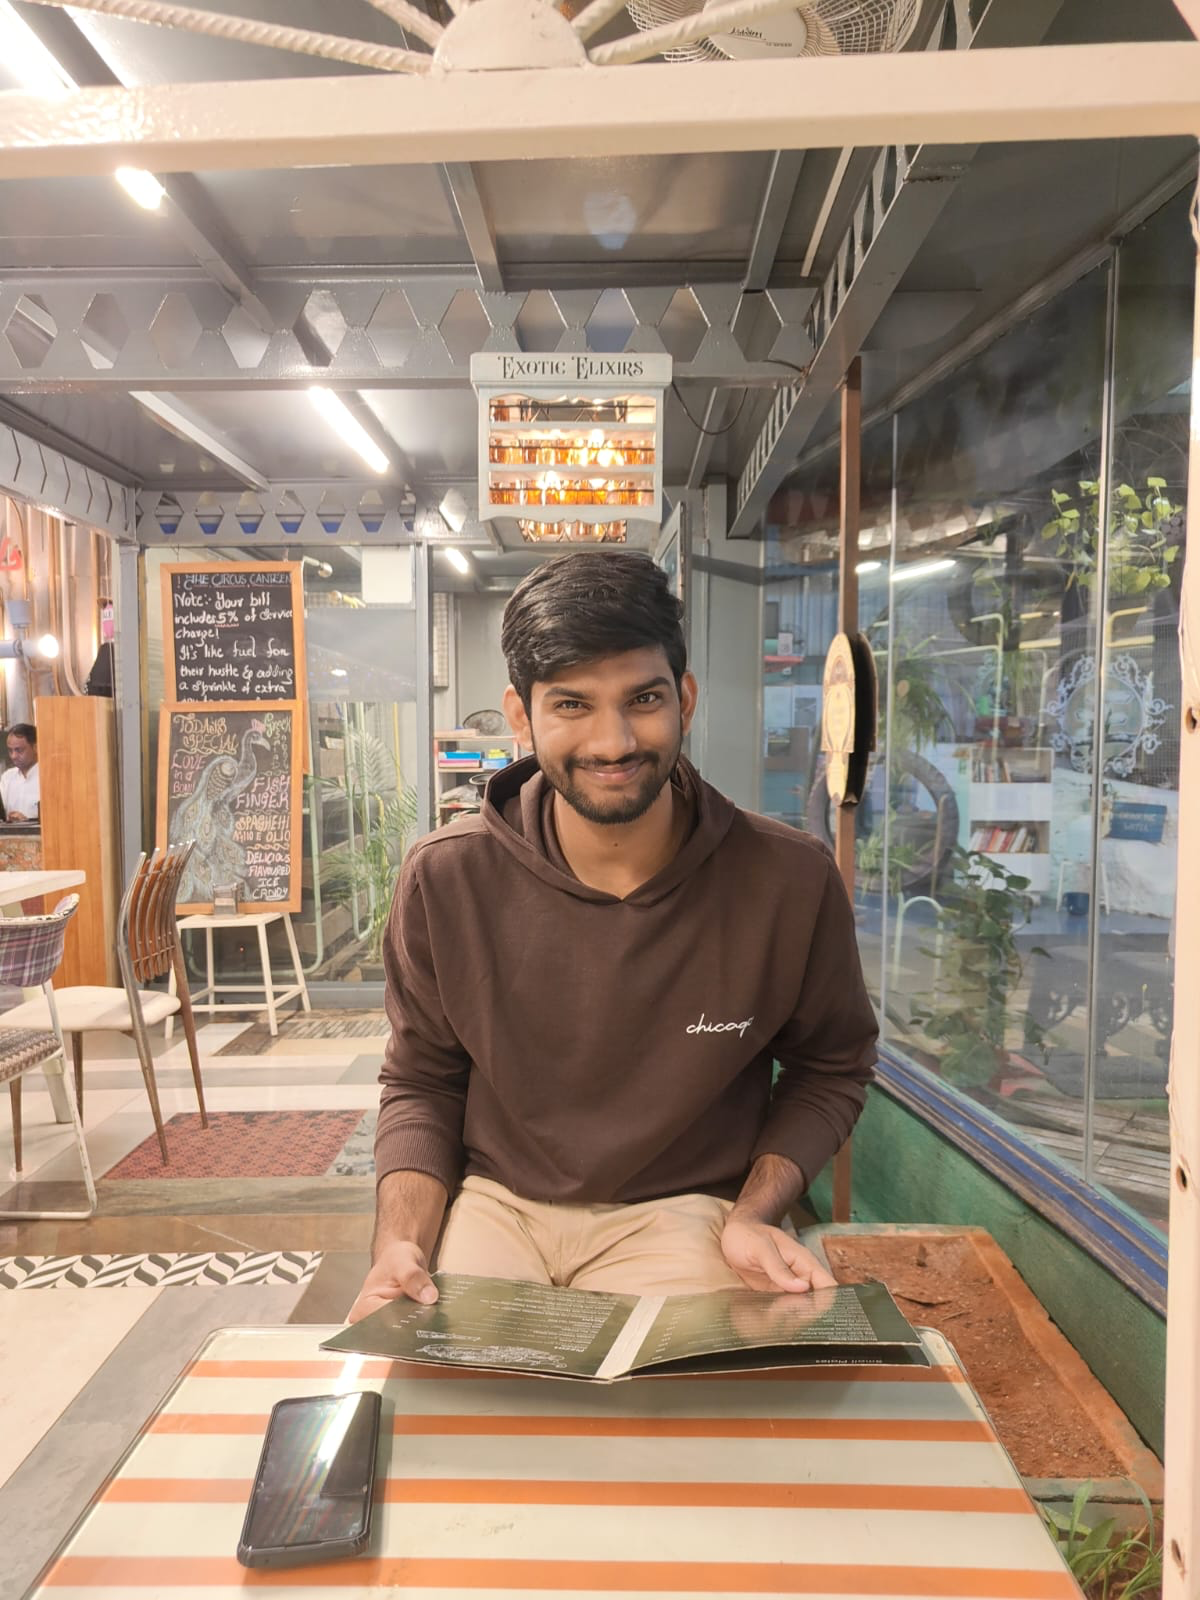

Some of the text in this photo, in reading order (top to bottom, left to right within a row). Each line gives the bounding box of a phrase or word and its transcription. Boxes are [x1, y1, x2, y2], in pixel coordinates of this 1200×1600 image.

[211, 574, 247, 586] CIRCUS
[249, 574, 291, 585] CANTEEN
[250, 591, 270, 607] bill
[174, 610, 216, 625] includes
[216, 610, 239, 624] 5%
[244, 607, 257, 622] of
[204, 643, 224, 658] like
[233, 636, 256, 658] fuel
[180, 664, 204, 677] their
[208, 663, 239, 677] hustle
[256, 664, 293, 685] adding
[179, 681, 188, 690] a
[241, 681, 250, 695] of
[254, 680, 286, 693] extra
[171, 753, 208, 770] LOVE
[251, 774, 290, 794] FISH
[235, 791, 290, 810] FINGER
[257, 877, 280, 888] ICE
